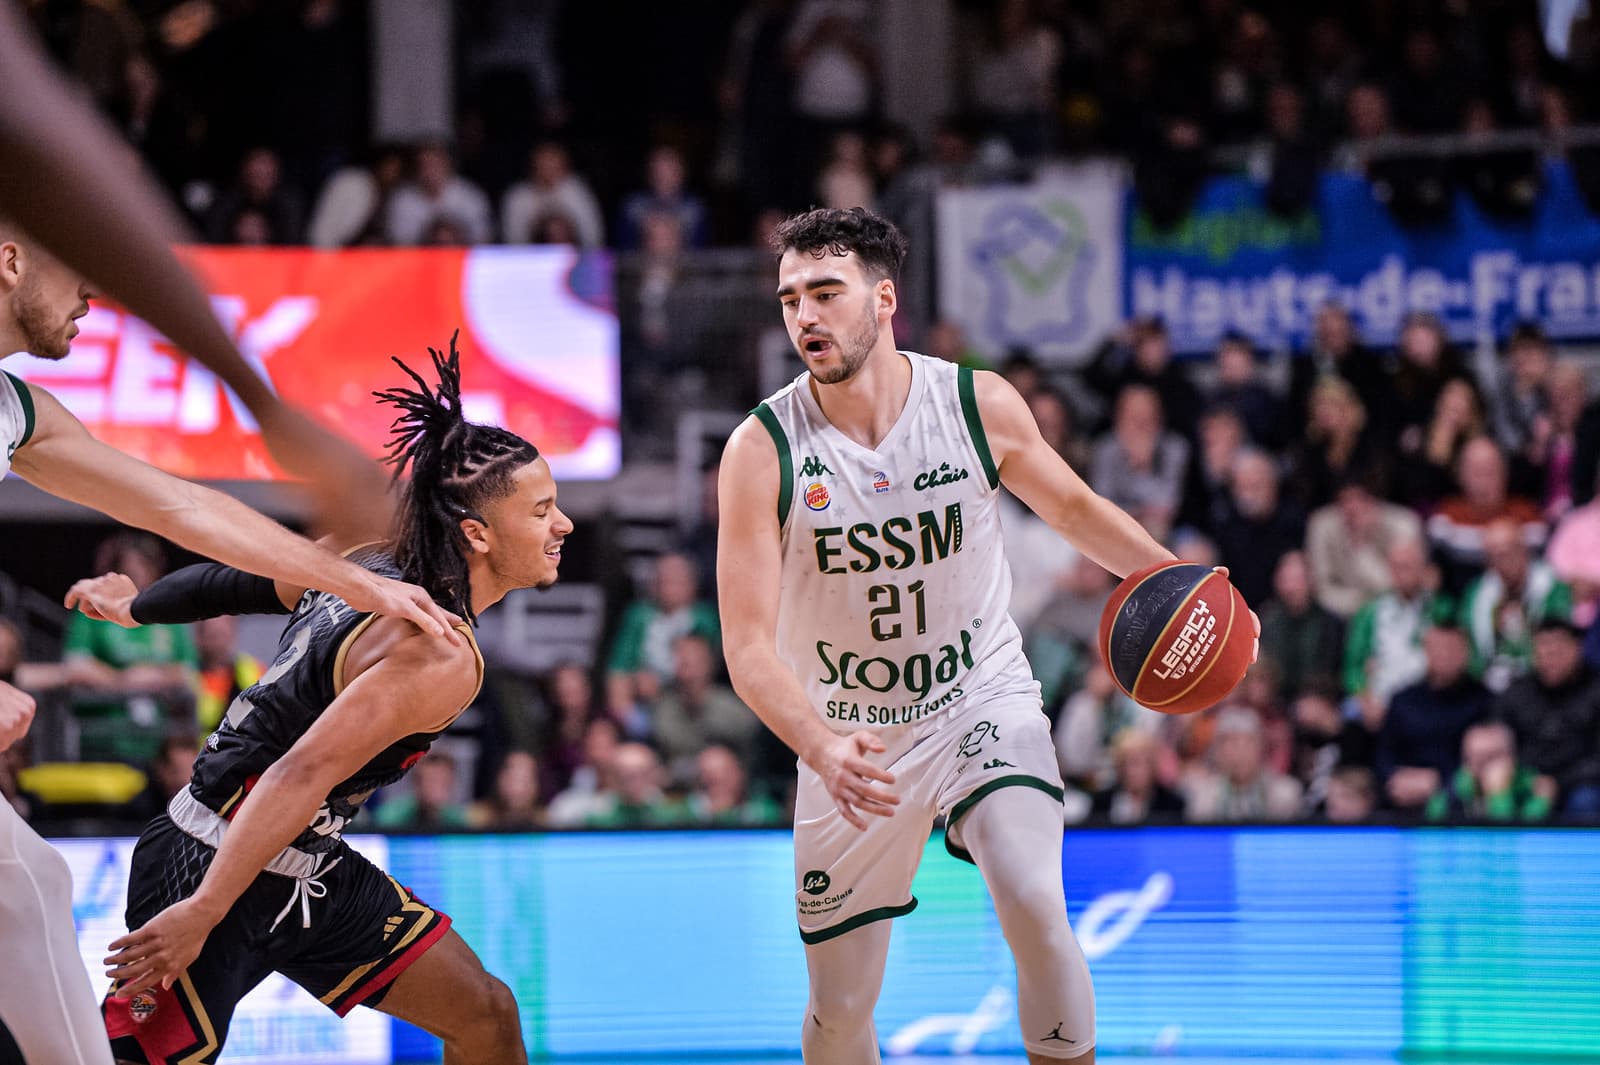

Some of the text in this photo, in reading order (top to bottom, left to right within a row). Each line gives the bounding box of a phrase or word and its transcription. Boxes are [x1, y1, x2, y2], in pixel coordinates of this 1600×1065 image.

[808, 492, 829, 506] KING
[913, 468, 969, 491] Chais
[814, 502, 963, 574] ESSM
[868, 579, 927, 642] 21
[1153, 599, 1210, 680] LEGACY
[1184, 614, 1217, 665] 1000
[826, 681, 964, 724] SEA SOLUTIONS
